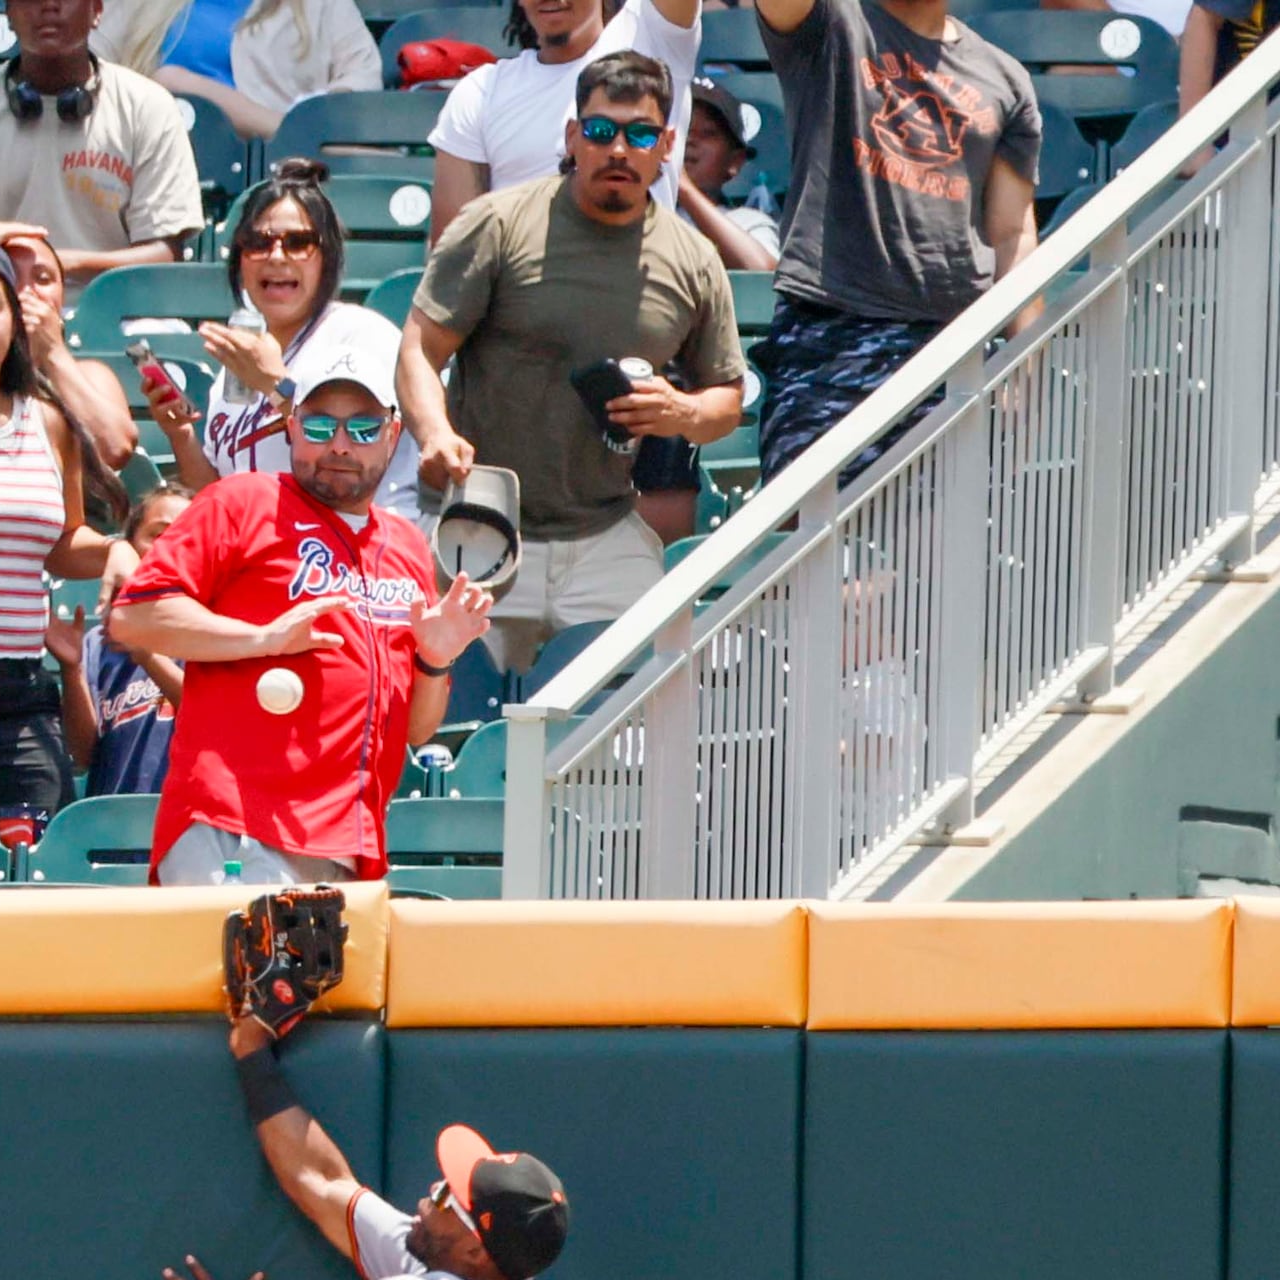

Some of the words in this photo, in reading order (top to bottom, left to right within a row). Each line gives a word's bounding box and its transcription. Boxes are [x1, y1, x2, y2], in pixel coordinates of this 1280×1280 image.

[62, 149, 135, 189] HAVANA
[852, 137, 969, 202] TIGERS
[325, 353, 357, 375] A
